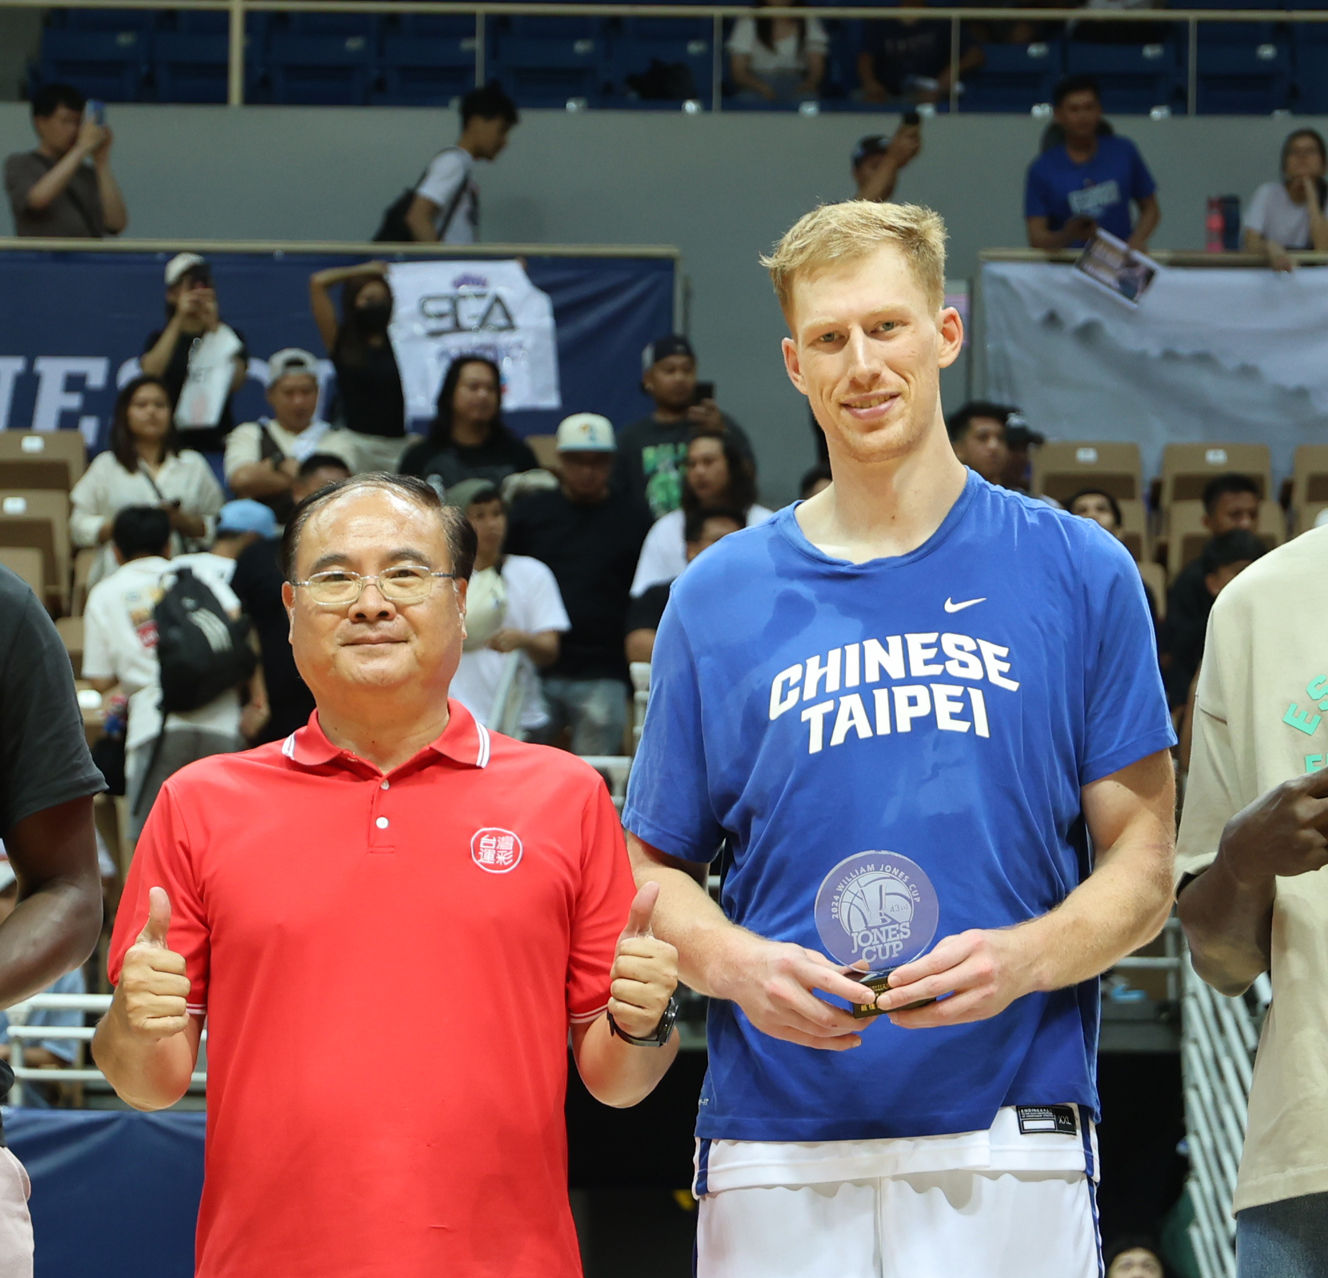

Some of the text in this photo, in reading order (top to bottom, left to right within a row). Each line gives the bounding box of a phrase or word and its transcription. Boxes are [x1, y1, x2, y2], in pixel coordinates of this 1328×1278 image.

[770, 631, 1020, 721] CHINESE
[800, 683, 990, 755] TAIPEI
[831, 864, 921, 920] 2024 WILLIAM JONES CUP
[850, 921, 912, 954] JONES
[861, 941, 904, 964] CUP
